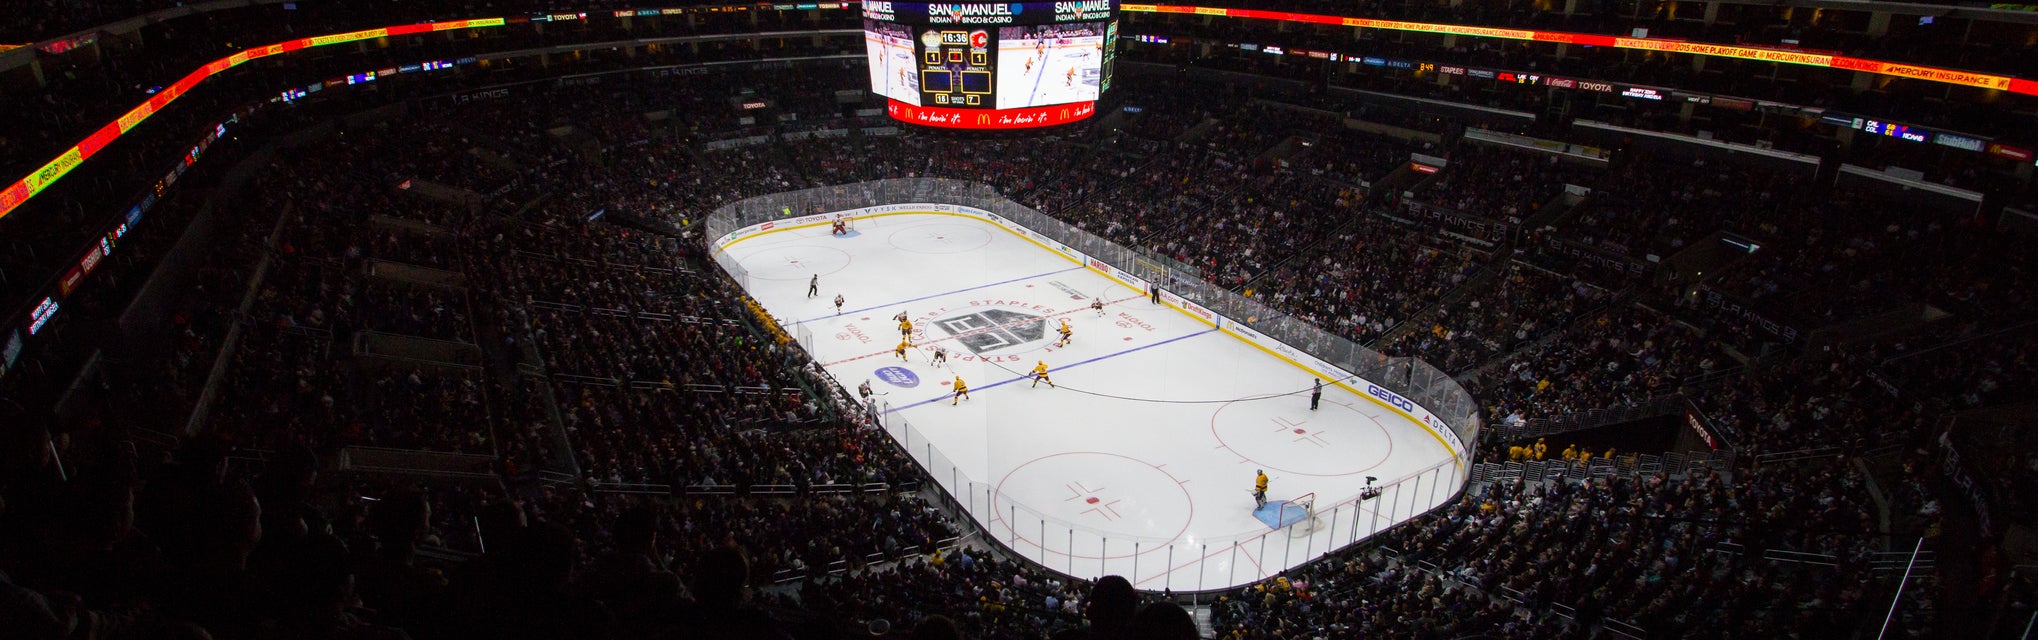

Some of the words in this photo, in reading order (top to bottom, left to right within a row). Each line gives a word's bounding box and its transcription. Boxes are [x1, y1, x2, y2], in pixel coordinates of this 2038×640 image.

[928, 4, 951, 15] SAN
[961, 4, 1012, 15] MANUEL
[1055, 2, 1075, 13] SAN
[1082, 0, 1110, 11] MANUEL
[943, 34, 966, 42] 16:36
[1620, 39, 1645, 48] TICKETS
[1710, 46, 1738, 56] PLAYOFF
[1738, 49, 1758, 58] GAME
[1440, 66, 1464, 75] STAPLES
[1895, 66, 1934, 78] MERCURY
[1936, 73, 1990, 85] INSURANCE
[1578, 82, 1612, 92] TOYOTA
[1902, 133, 1924, 142] NCAAB
[1444, 214, 1486, 230] KINGS
[1090, 259, 1108, 272] HARIBO
[1118, 271, 1138, 282] AMERICAN
[969, 300, 1055, 314] STAPLES
[1188, 303, 1212, 319] DraftKings
[1118, 312, 1156, 332] TOYOTA
[845, 323, 872, 344] TOYOTA
[1236, 326, 1257, 339] McDonald's
[1368, 384, 1413, 413] GEICO
[1433, 420, 1456, 447] DELTA
[1689, 414, 1711, 447] TOYOTA
